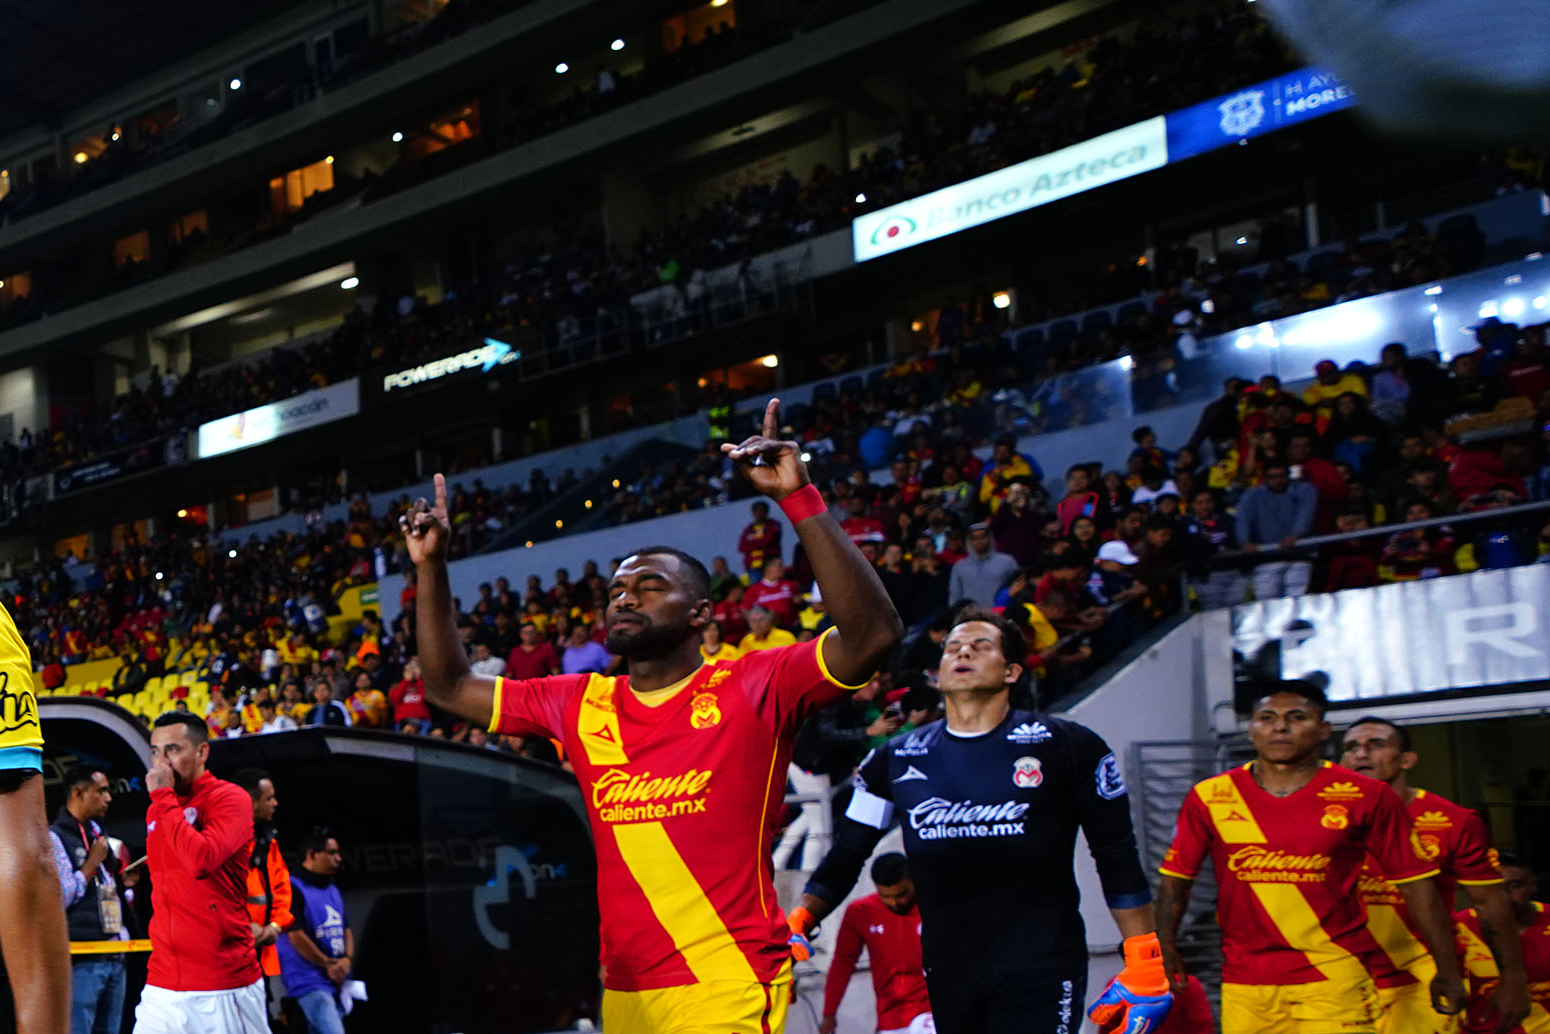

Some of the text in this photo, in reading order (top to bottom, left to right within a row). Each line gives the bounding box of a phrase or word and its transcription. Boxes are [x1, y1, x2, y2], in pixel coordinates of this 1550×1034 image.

[1286, 85, 1354, 116] MORE
[927, 145, 1148, 230] Banco Azteca
[591, 768, 713, 809] Caliente
[600, 798, 707, 822] caliente.mx
[907, 797, 1030, 830] Caliente
[918, 820, 1026, 841] caliente.mx
[1227, 845, 1331, 872] Caliente
[1236, 869, 1327, 883] caliente.mx
